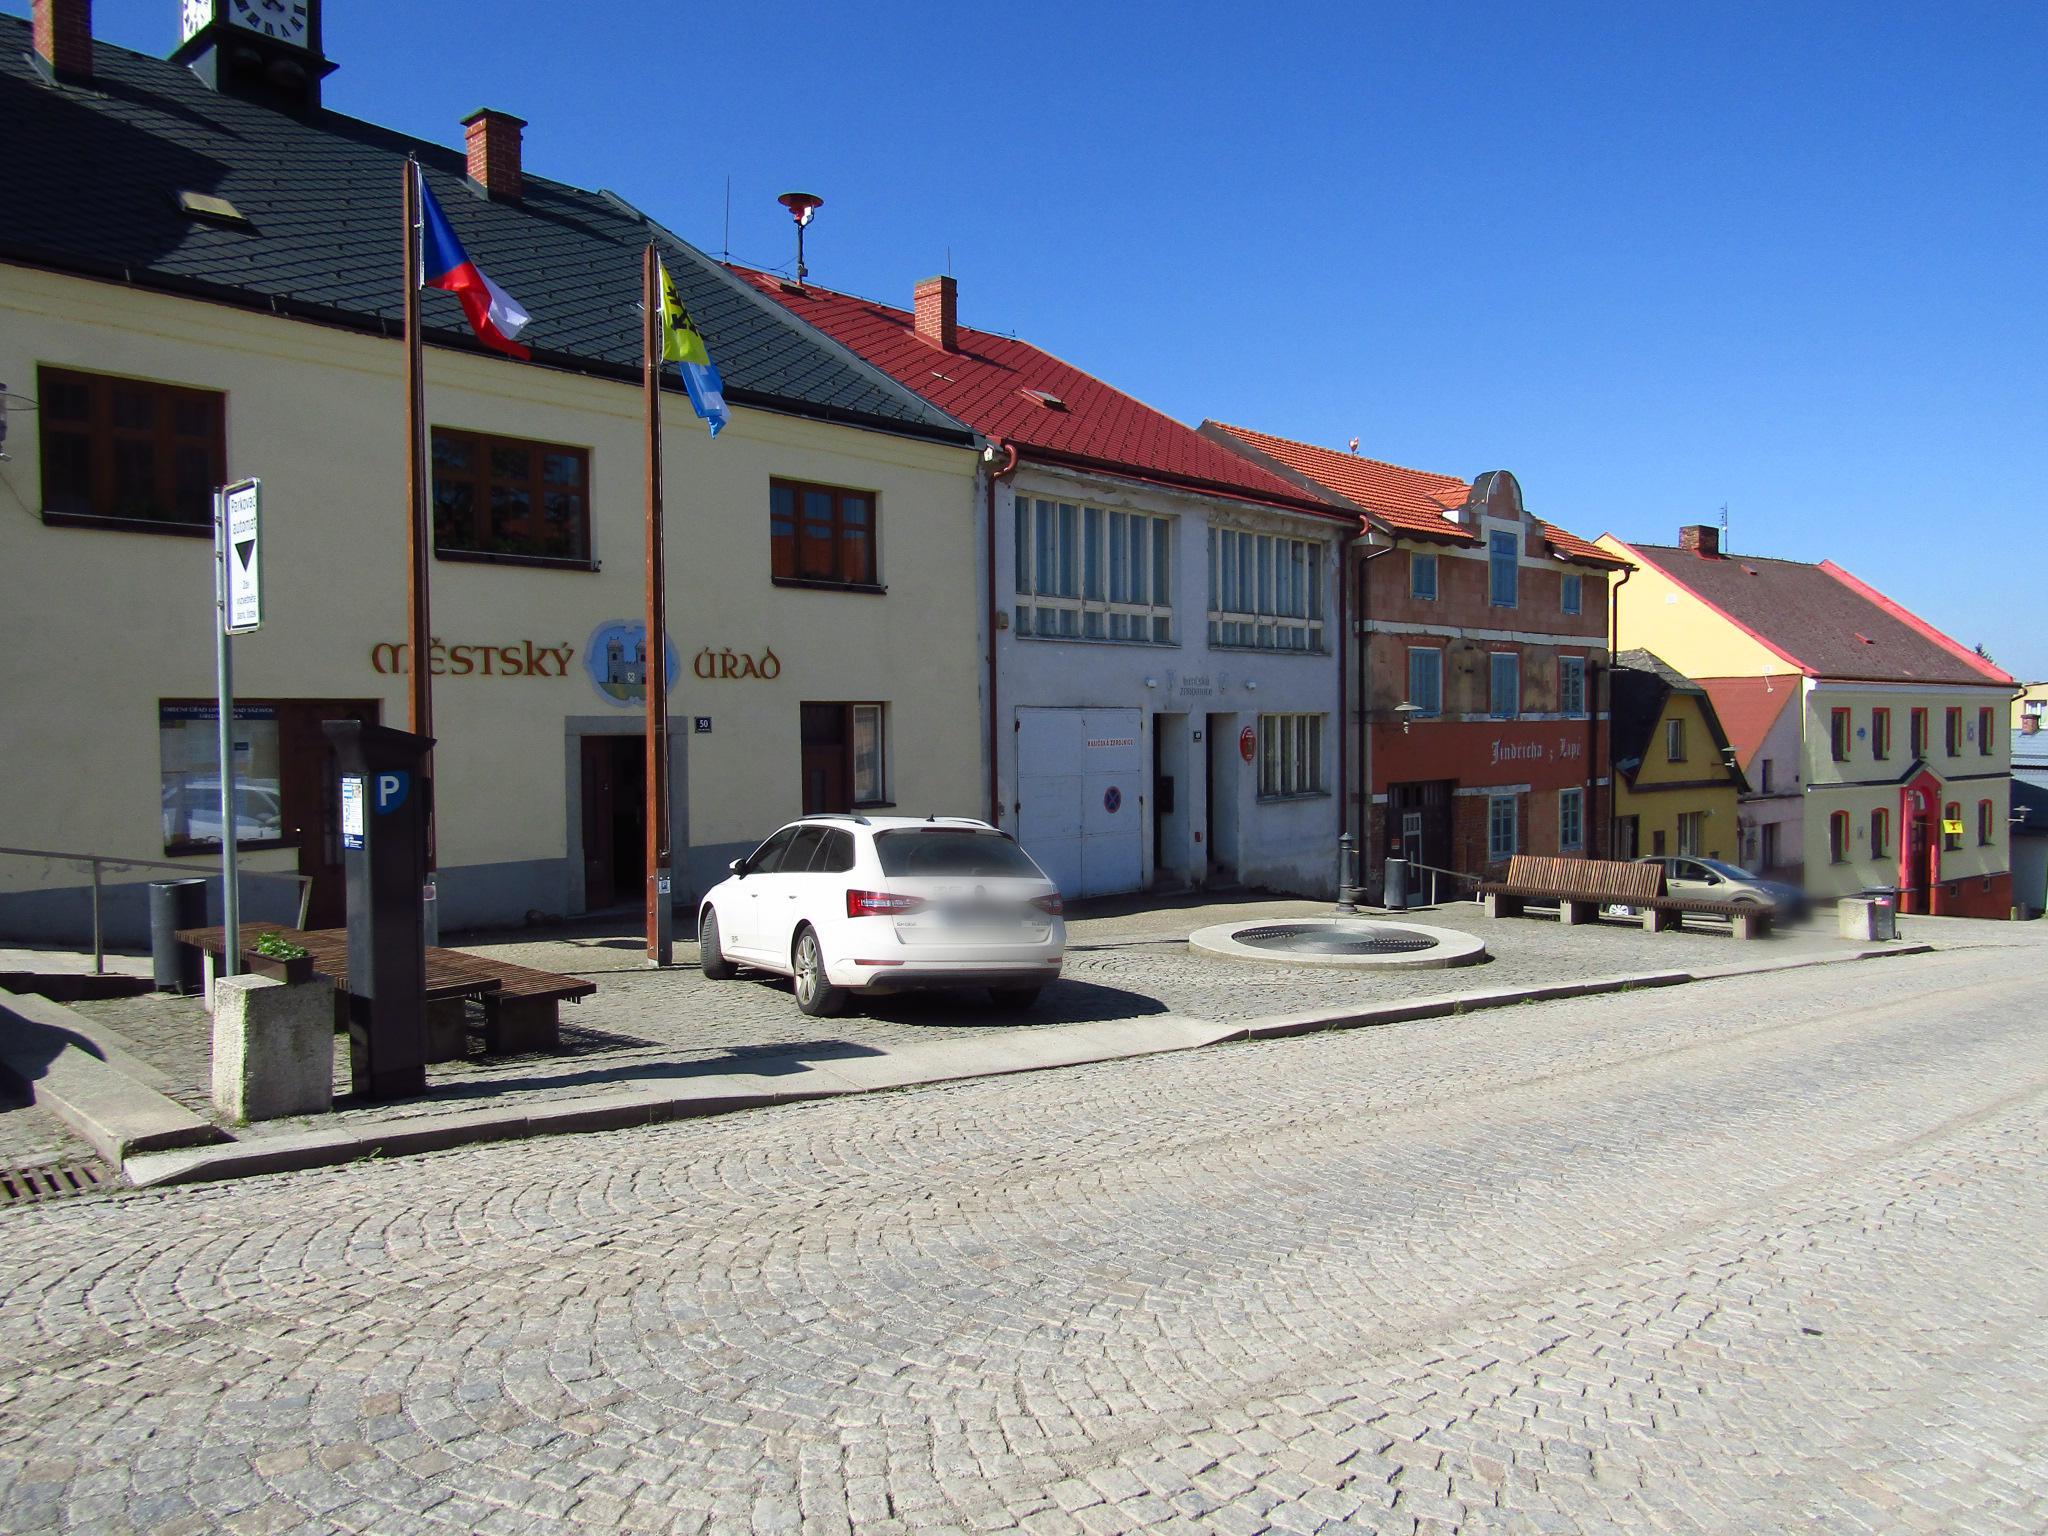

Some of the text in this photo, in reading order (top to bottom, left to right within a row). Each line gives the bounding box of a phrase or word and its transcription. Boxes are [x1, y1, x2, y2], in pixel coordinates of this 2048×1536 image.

[694, 646, 781, 679] ÚŘAD
[699, 719, 709, 728] 50
[380, 775, 400, 806] P
